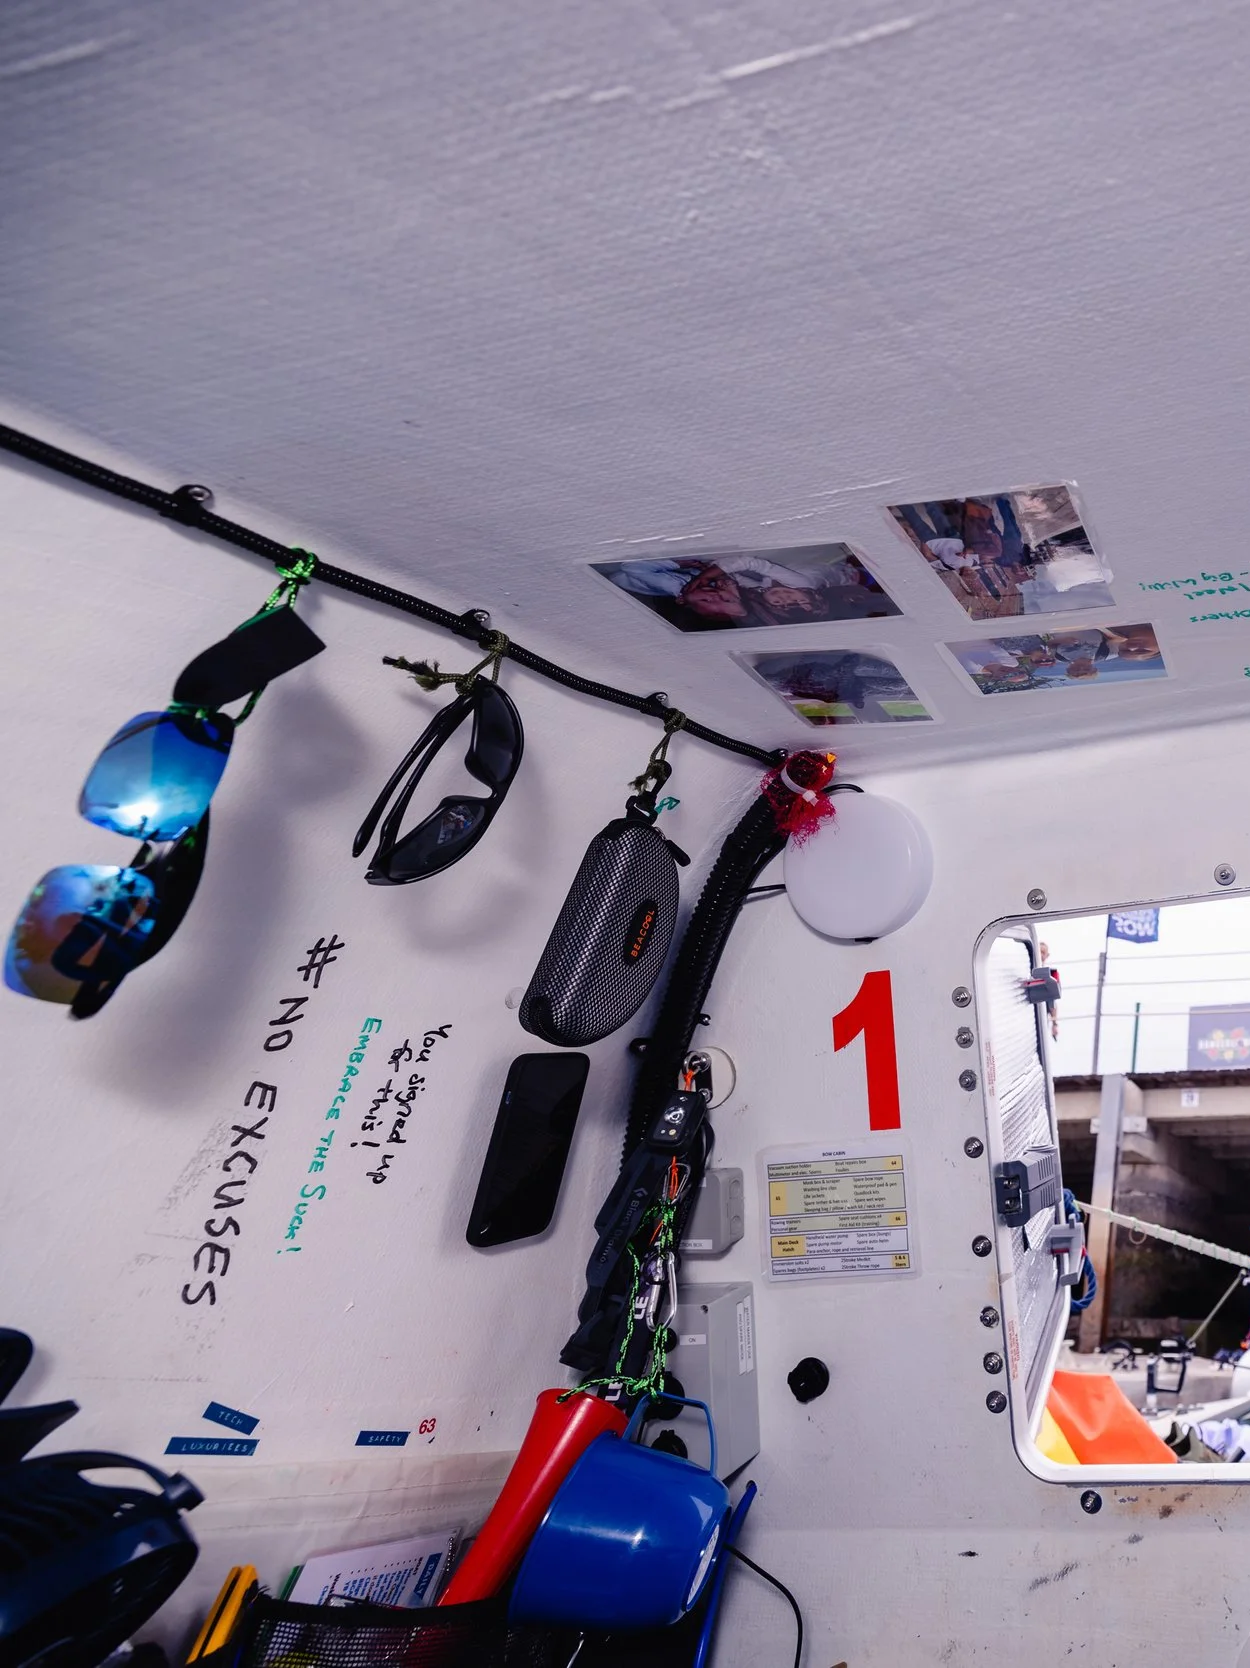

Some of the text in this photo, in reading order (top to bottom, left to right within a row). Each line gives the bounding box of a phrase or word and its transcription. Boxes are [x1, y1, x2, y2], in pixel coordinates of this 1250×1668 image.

[631, 910, 655, 957] BEACOOL
[388, 1038, 412, 1073] for
[832, 970, 901, 1131] 1
[387, 1073, 425, 1144] signed
[308, 1130, 335, 1173] THE
[366, 1154, 395, 1185] up
[181, 1080, 278, 1306] EXCUSES
[218, 1411, 243, 1426] TECH
[419, 1418, 436, 1435] 63
[368, 1434, 402, 1443] SAFETY
[417, 1563, 435, 1595] DAILY
